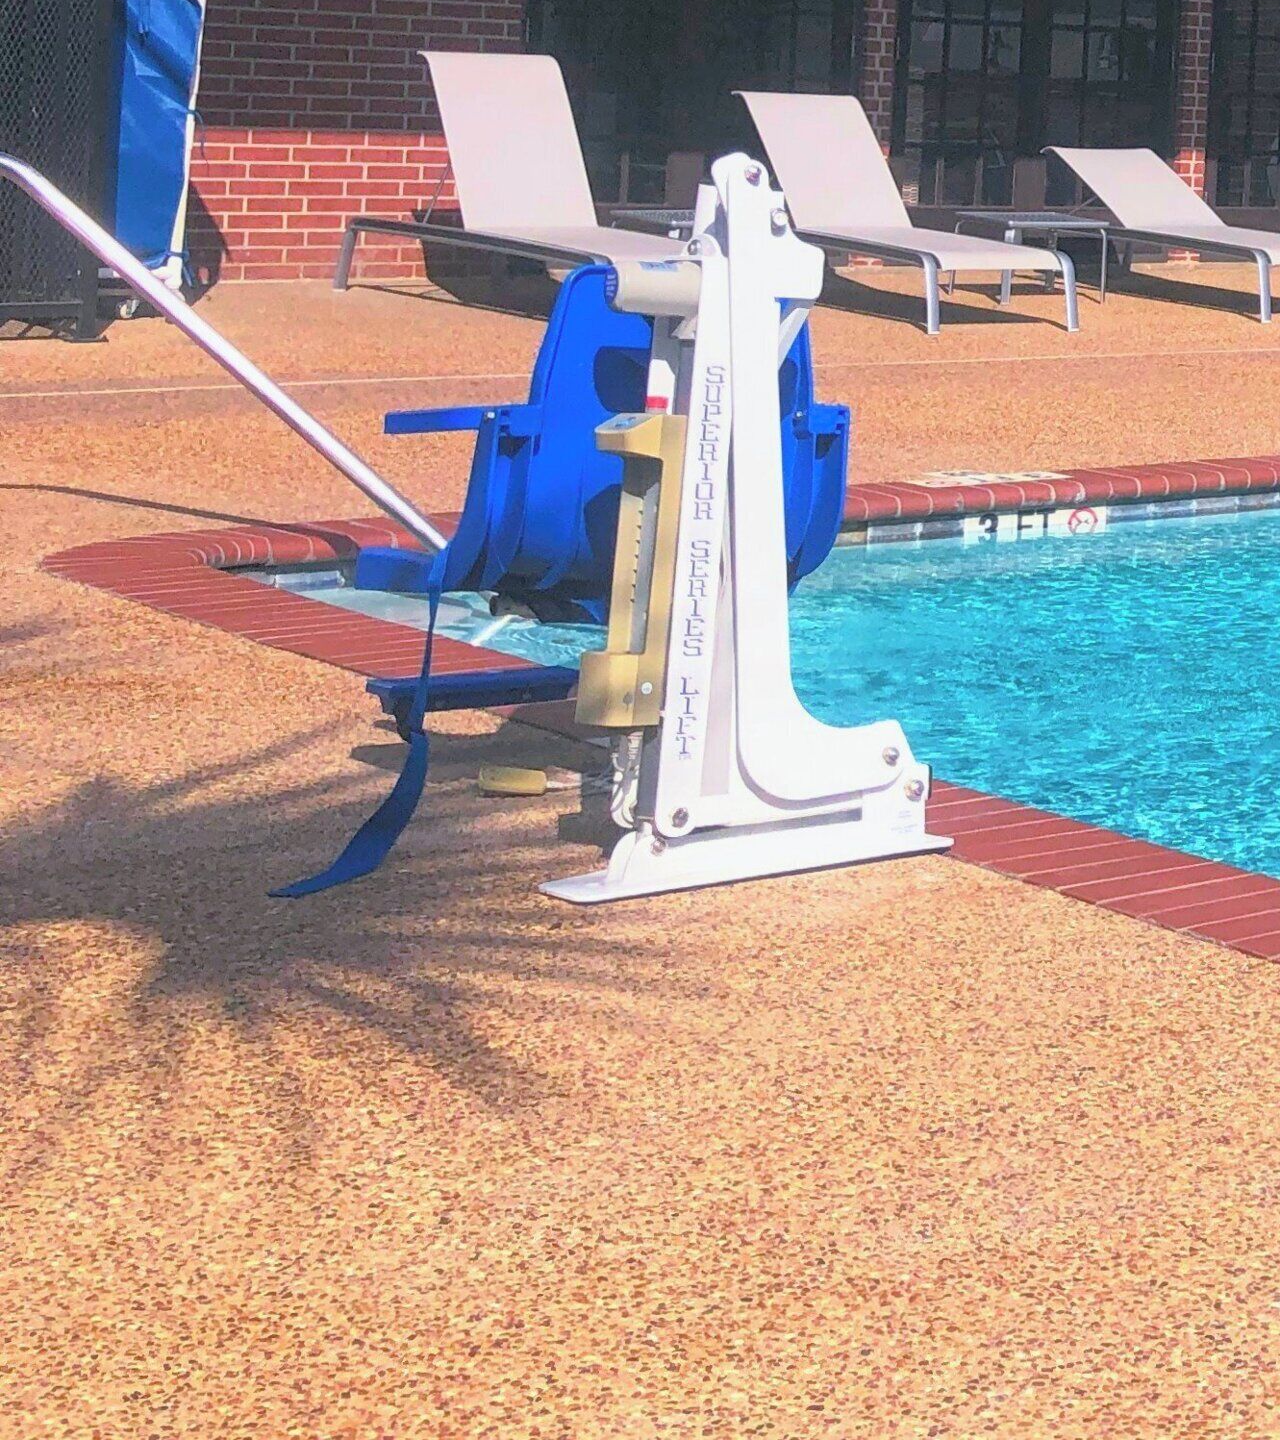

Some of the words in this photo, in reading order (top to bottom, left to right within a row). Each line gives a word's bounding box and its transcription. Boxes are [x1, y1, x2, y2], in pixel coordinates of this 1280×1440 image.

[693, 365, 726, 520] SUPERIOR
[978, 513, 999, 540] 3
[1017, 509, 1056, 535] FT
[683, 539, 712, 657] SERIES
[675, 676, 700, 755] LIFT
